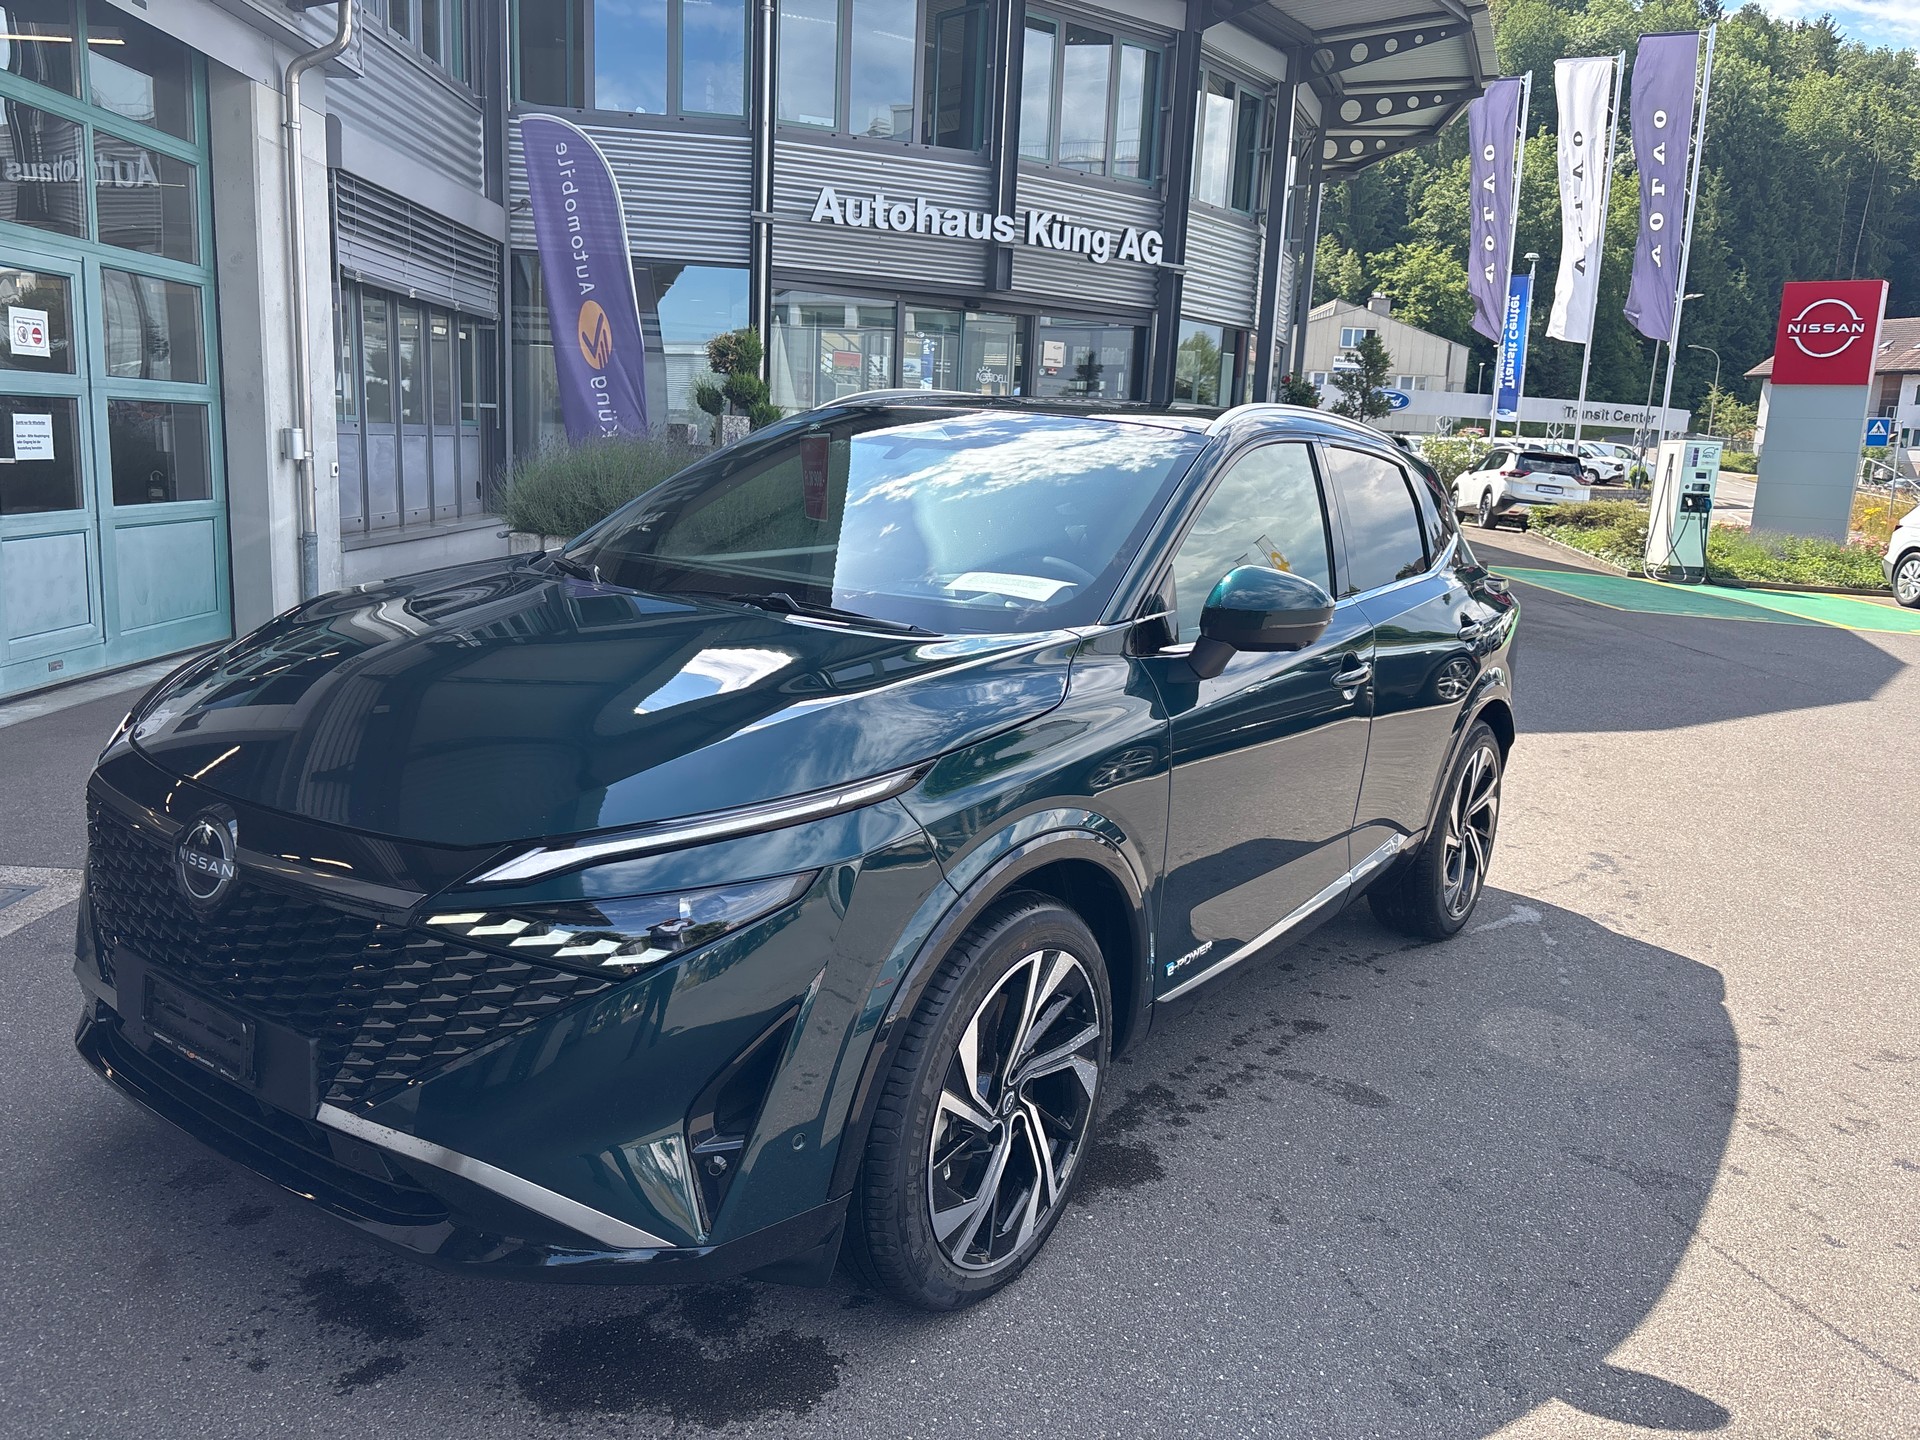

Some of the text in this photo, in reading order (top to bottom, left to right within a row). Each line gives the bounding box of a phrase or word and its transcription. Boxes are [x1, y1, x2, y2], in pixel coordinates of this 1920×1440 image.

[811, 186, 1164, 265] Autohaus Küng AG
[1787, 323, 1865, 334] NISSAN
[179, 846, 235, 878] NISSAN
